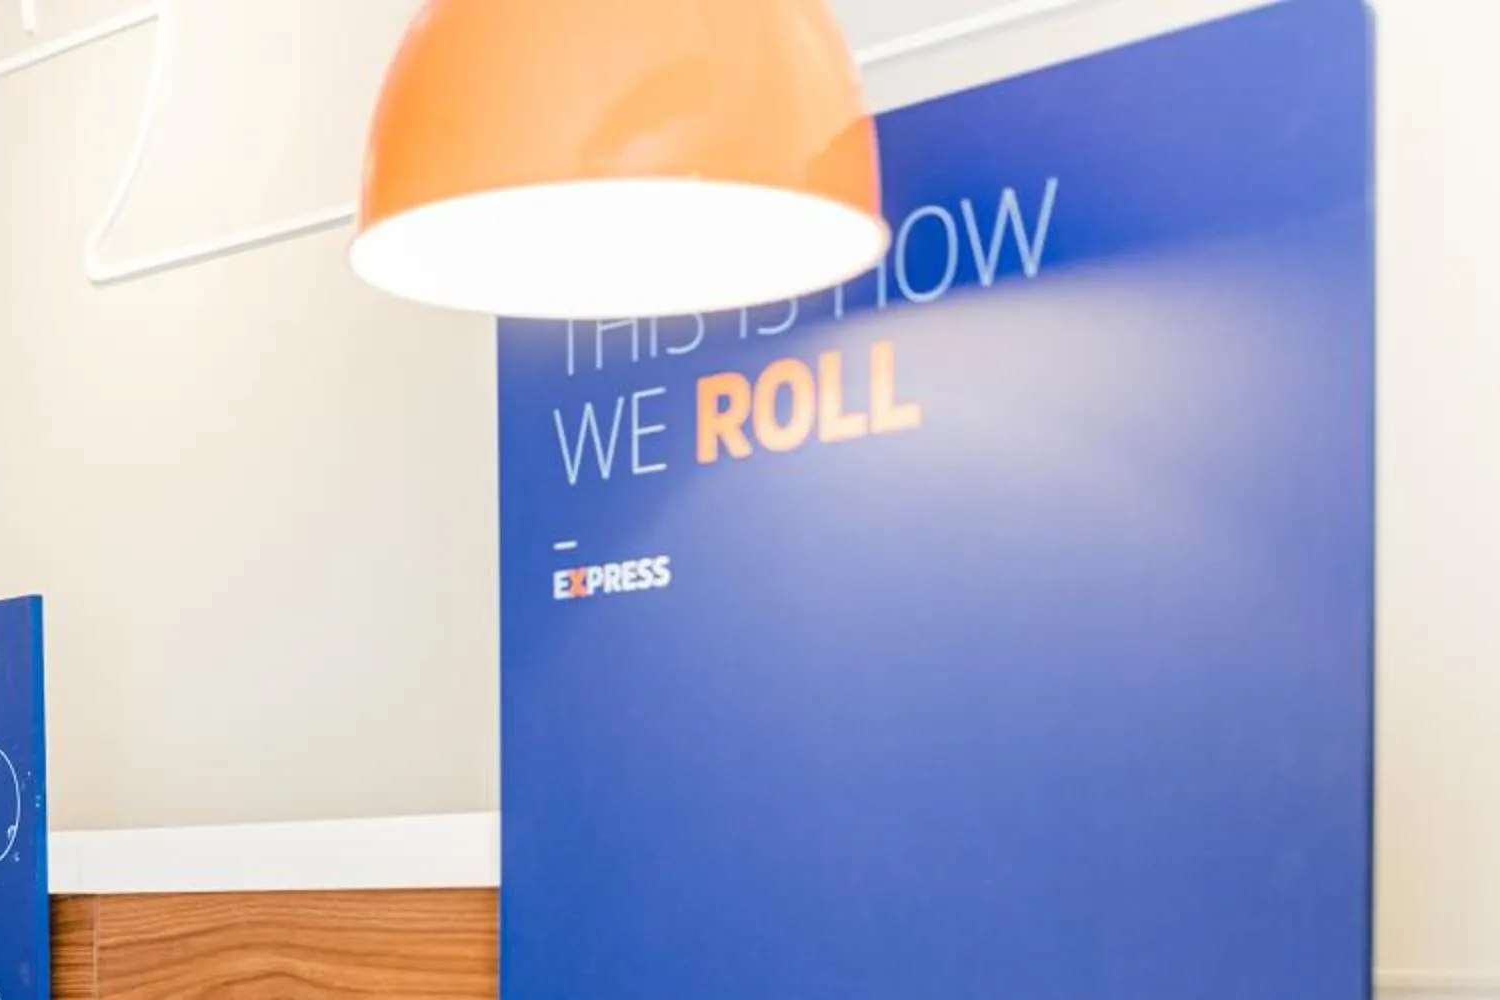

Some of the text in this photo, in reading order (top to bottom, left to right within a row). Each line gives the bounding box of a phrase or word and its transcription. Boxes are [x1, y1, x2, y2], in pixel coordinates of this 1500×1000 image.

[553, 340, 923, 485] WE ROLL
[552, 556, 671, 599] EXPRESS
